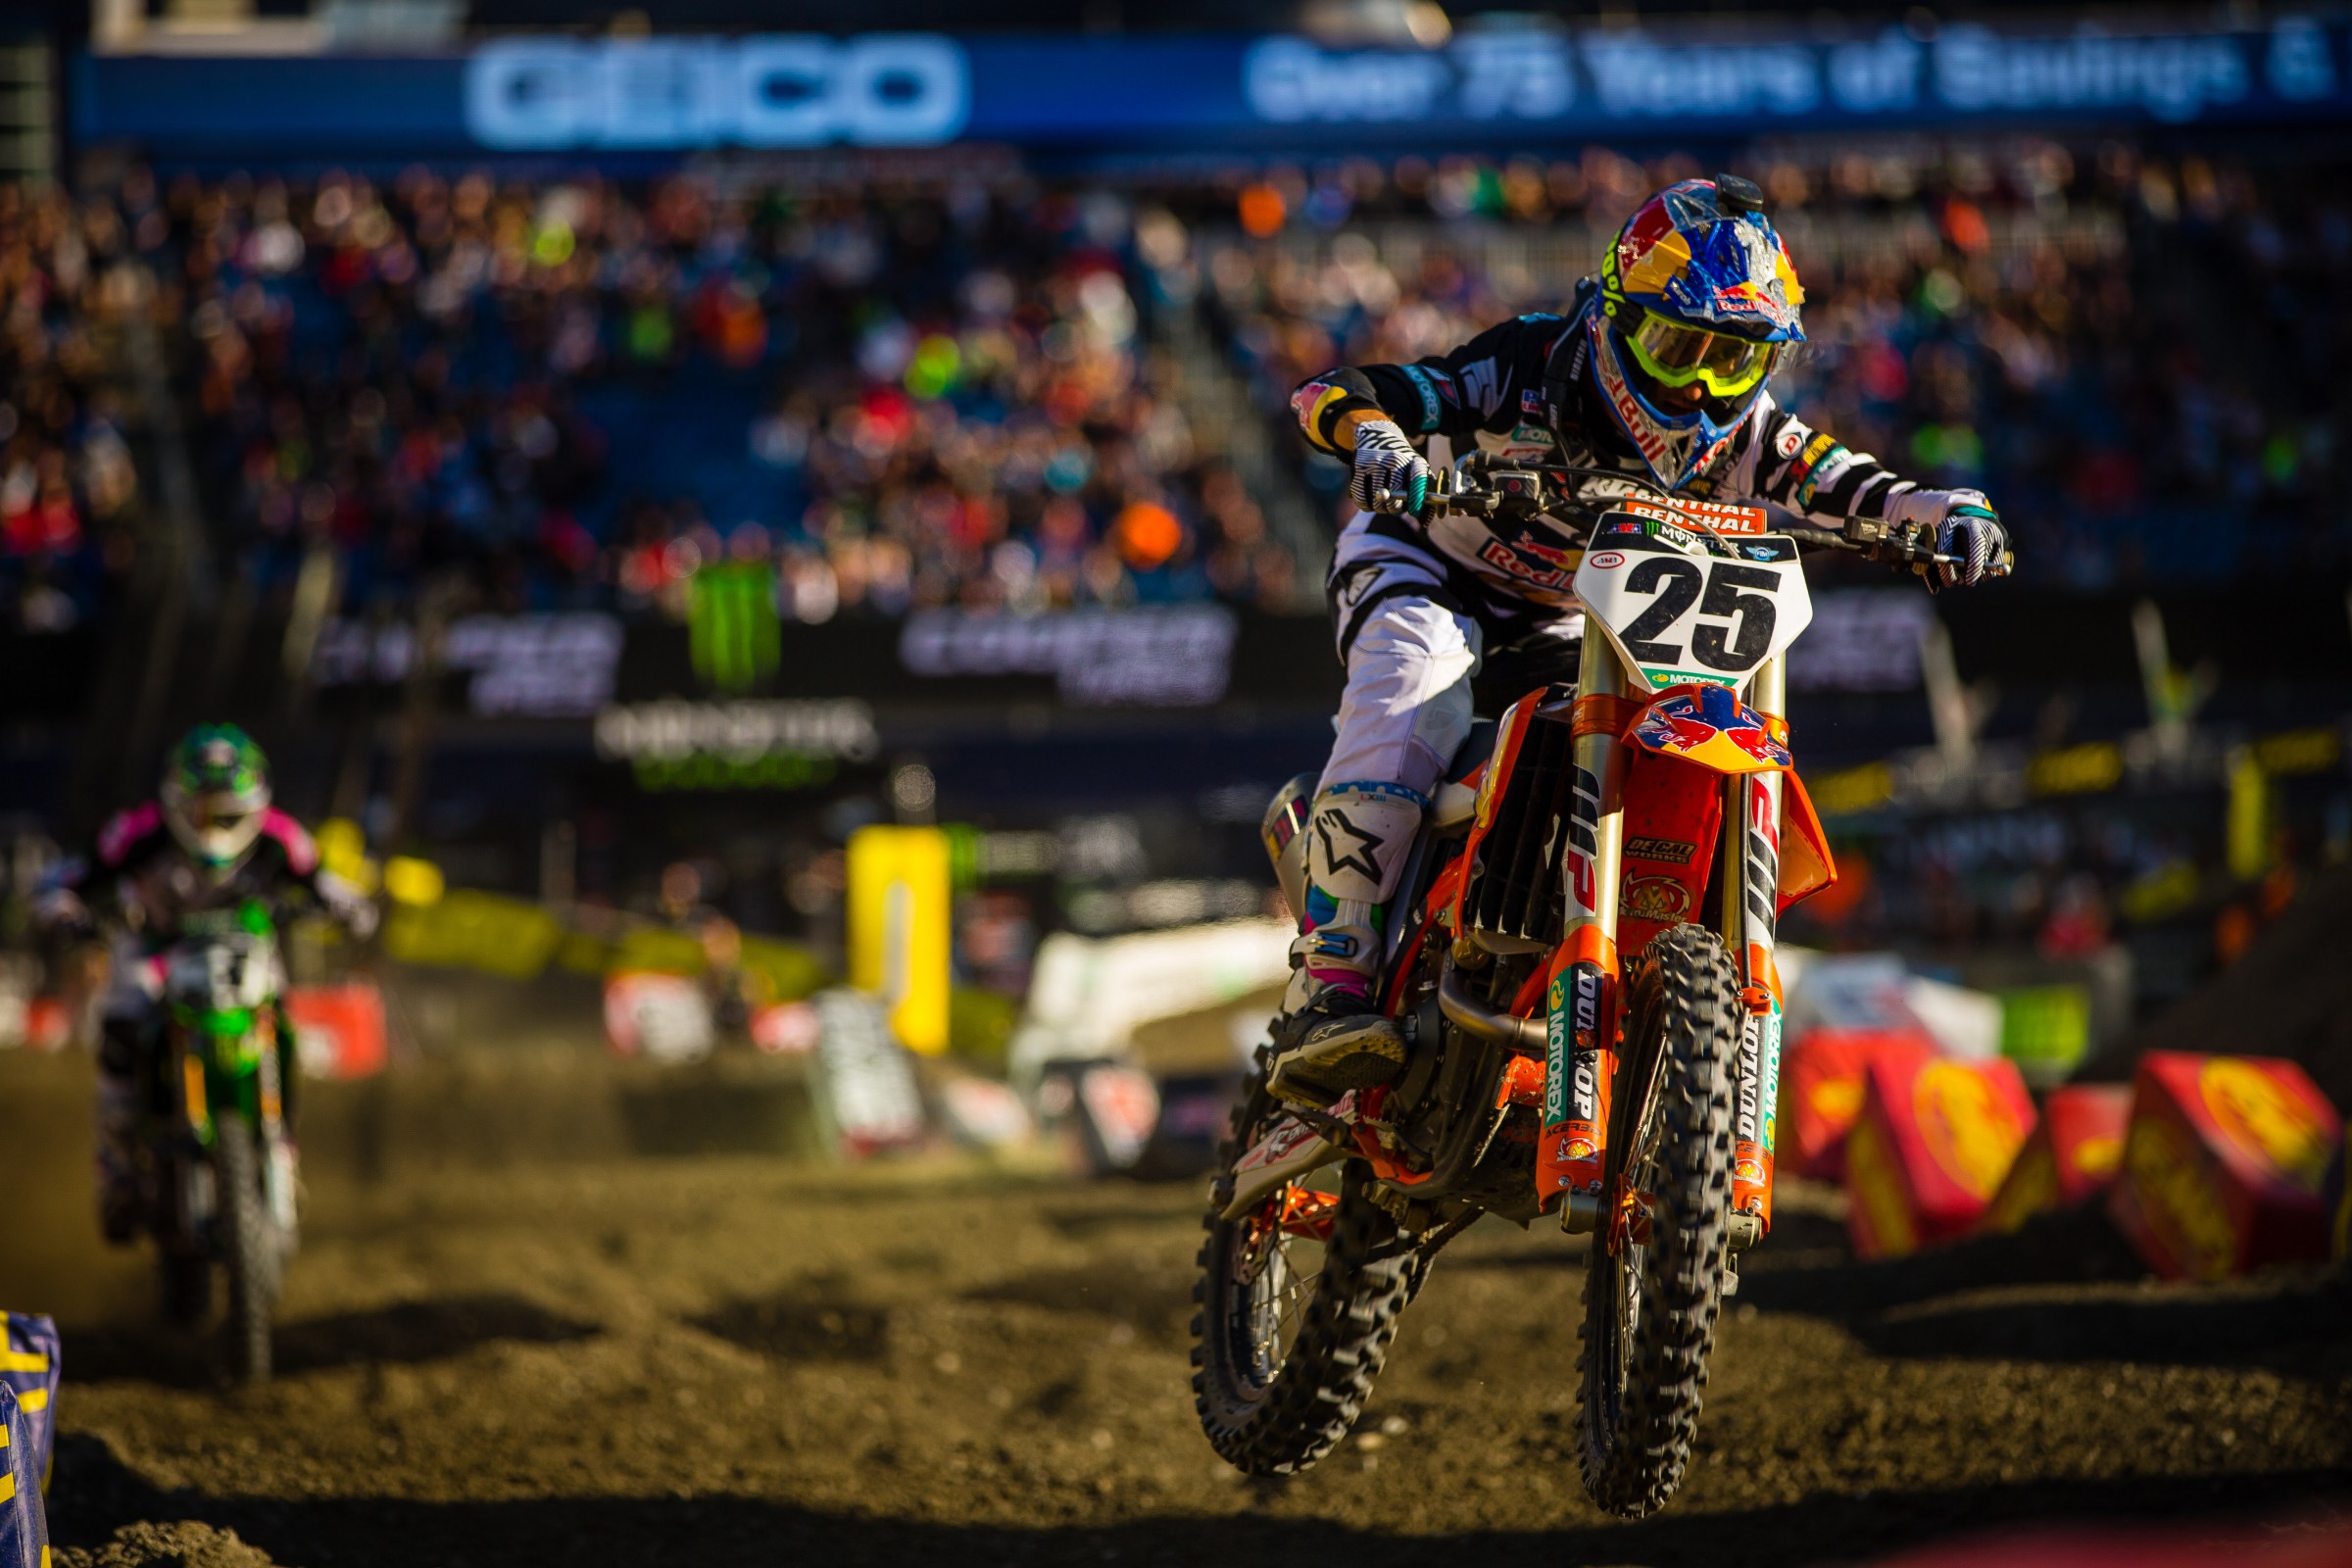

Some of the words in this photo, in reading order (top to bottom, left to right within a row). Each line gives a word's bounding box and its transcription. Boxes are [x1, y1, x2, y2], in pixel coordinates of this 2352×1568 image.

[464, 32, 972, 151] GEICO
[1244, 33, 1445, 122] Over
[1586, 27, 1821, 117] Years
[1829, 27, 1923, 114] of
[1935, 24, 2249, 120] Savings
[1717, 298, 1757, 315] Red
[1618, 394, 1667, 464] Bull
[1483, 541, 1563, 587] Red
[1634, 506, 1756, 533] RENTHAL
[1617, 557, 1782, 672] 25
[1545, 1009, 1566, 1123] MOTOREX
[1573, 968, 1596, 1120] DUOP
[1764, 1011, 1783, 1116] MOTOREX
